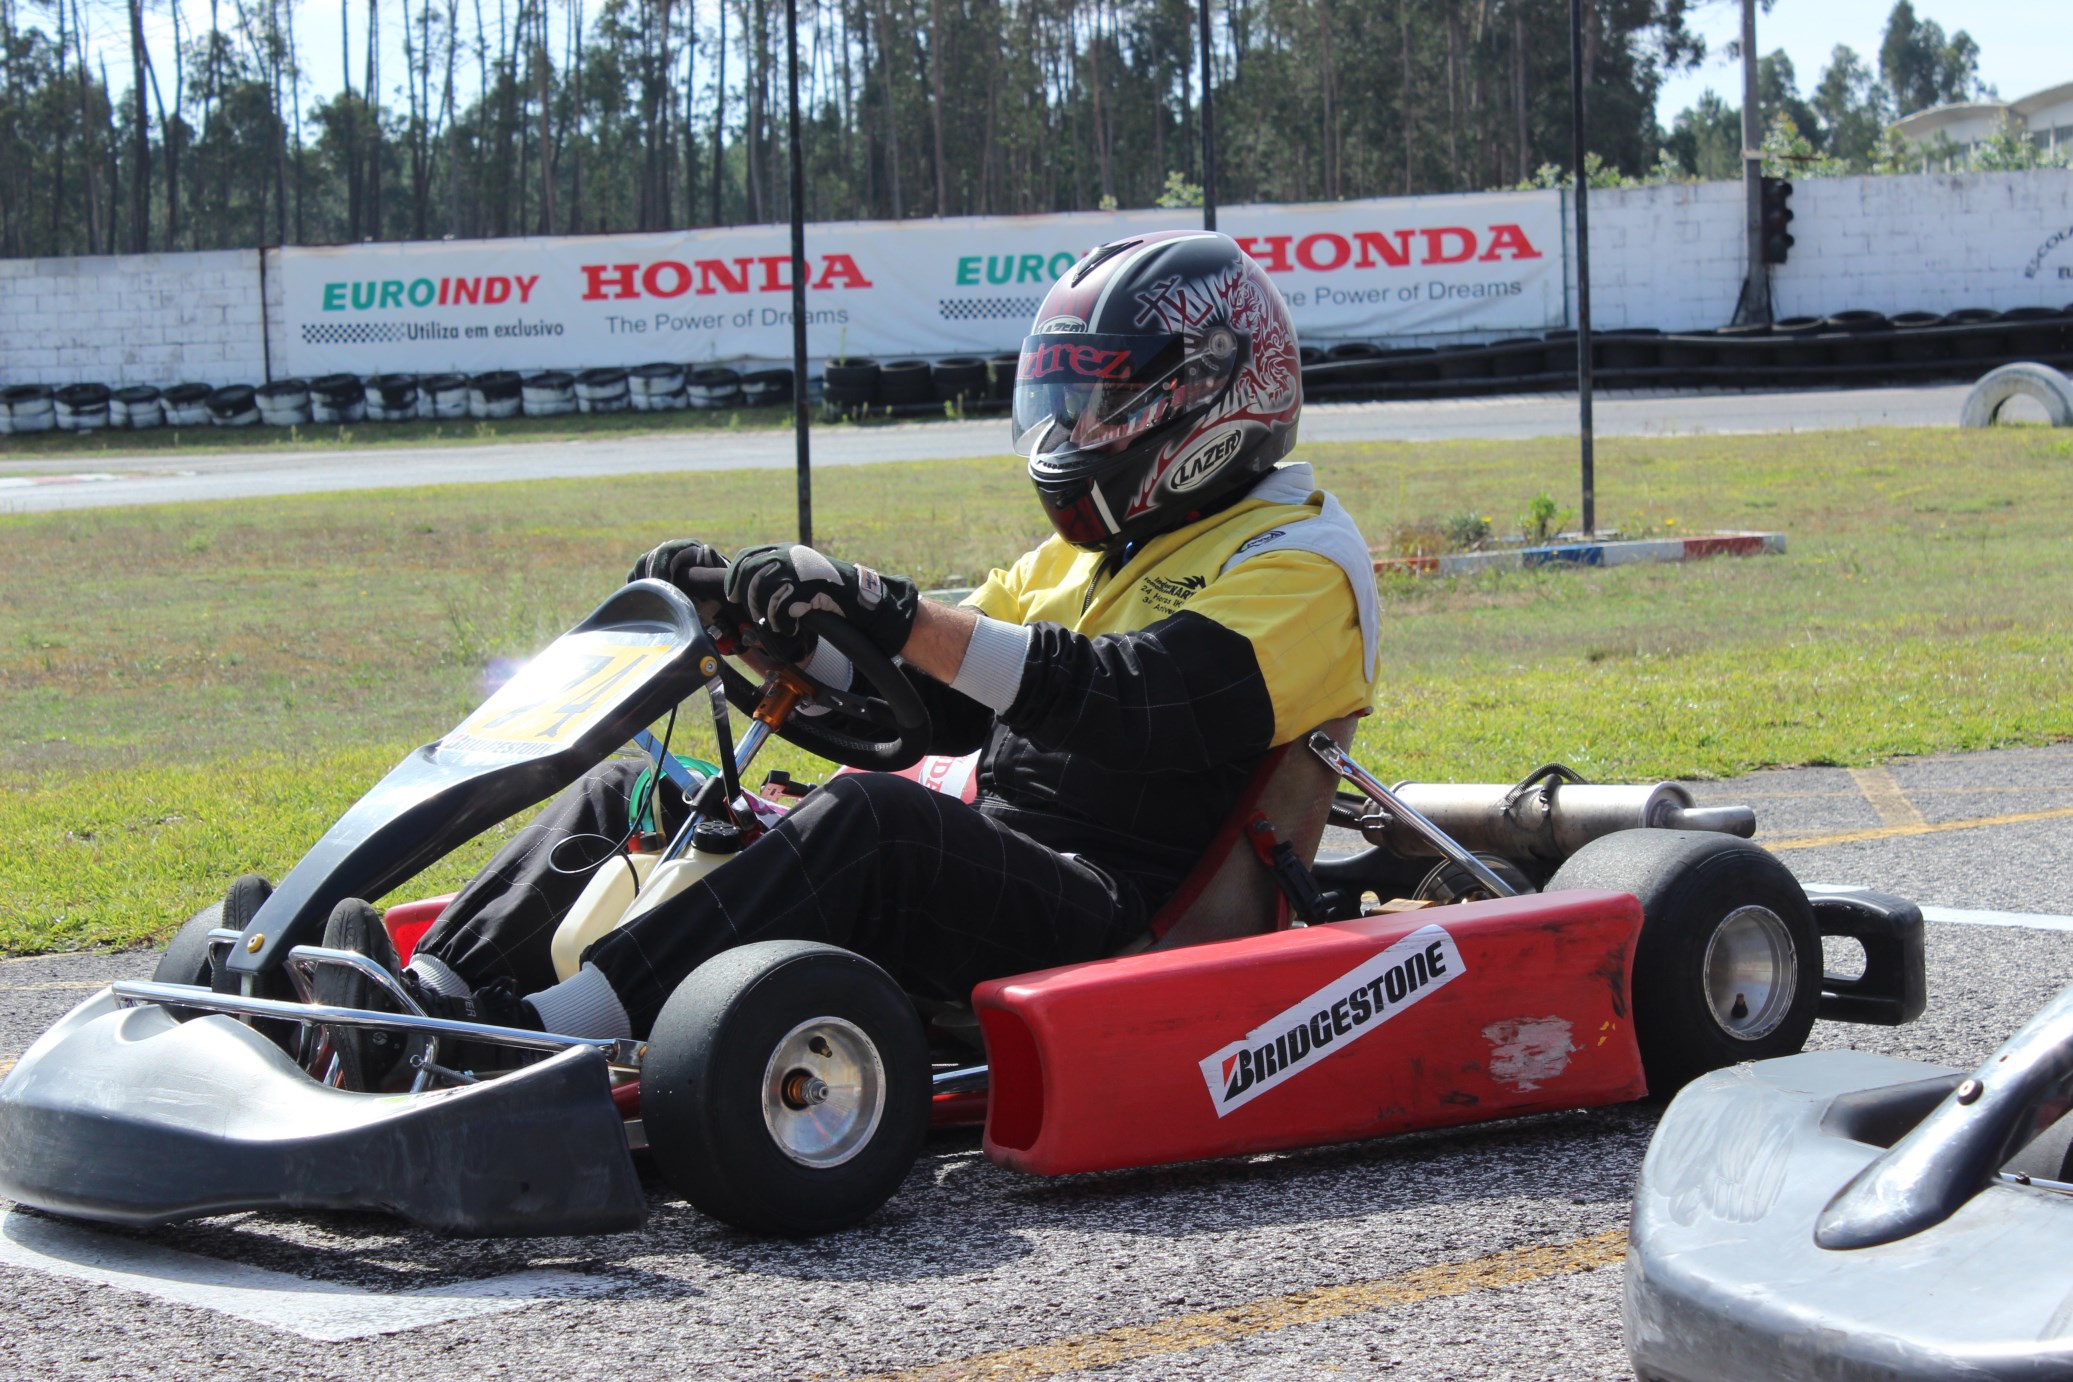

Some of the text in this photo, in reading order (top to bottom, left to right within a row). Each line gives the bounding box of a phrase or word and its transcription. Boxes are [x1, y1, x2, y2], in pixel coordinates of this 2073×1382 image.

[1232, 223, 1543, 273] HONDA
[580, 253, 873, 300] HONDA
[956, 251, 1089, 286] EURO
[322, 275, 540, 311] EUROINDY
[1279, 279, 1522, 306] he Power of Dreams
[406, 318, 564, 340] Utiliza em exclusivo
[605, 315, 647, 334] The
[655, 312, 723, 332] Power
[733, 308, 754, 328] of
[1180, 435, 1236, 483] LAZER
[1222, 940, 1447, 1103] BRIDGESTONE
